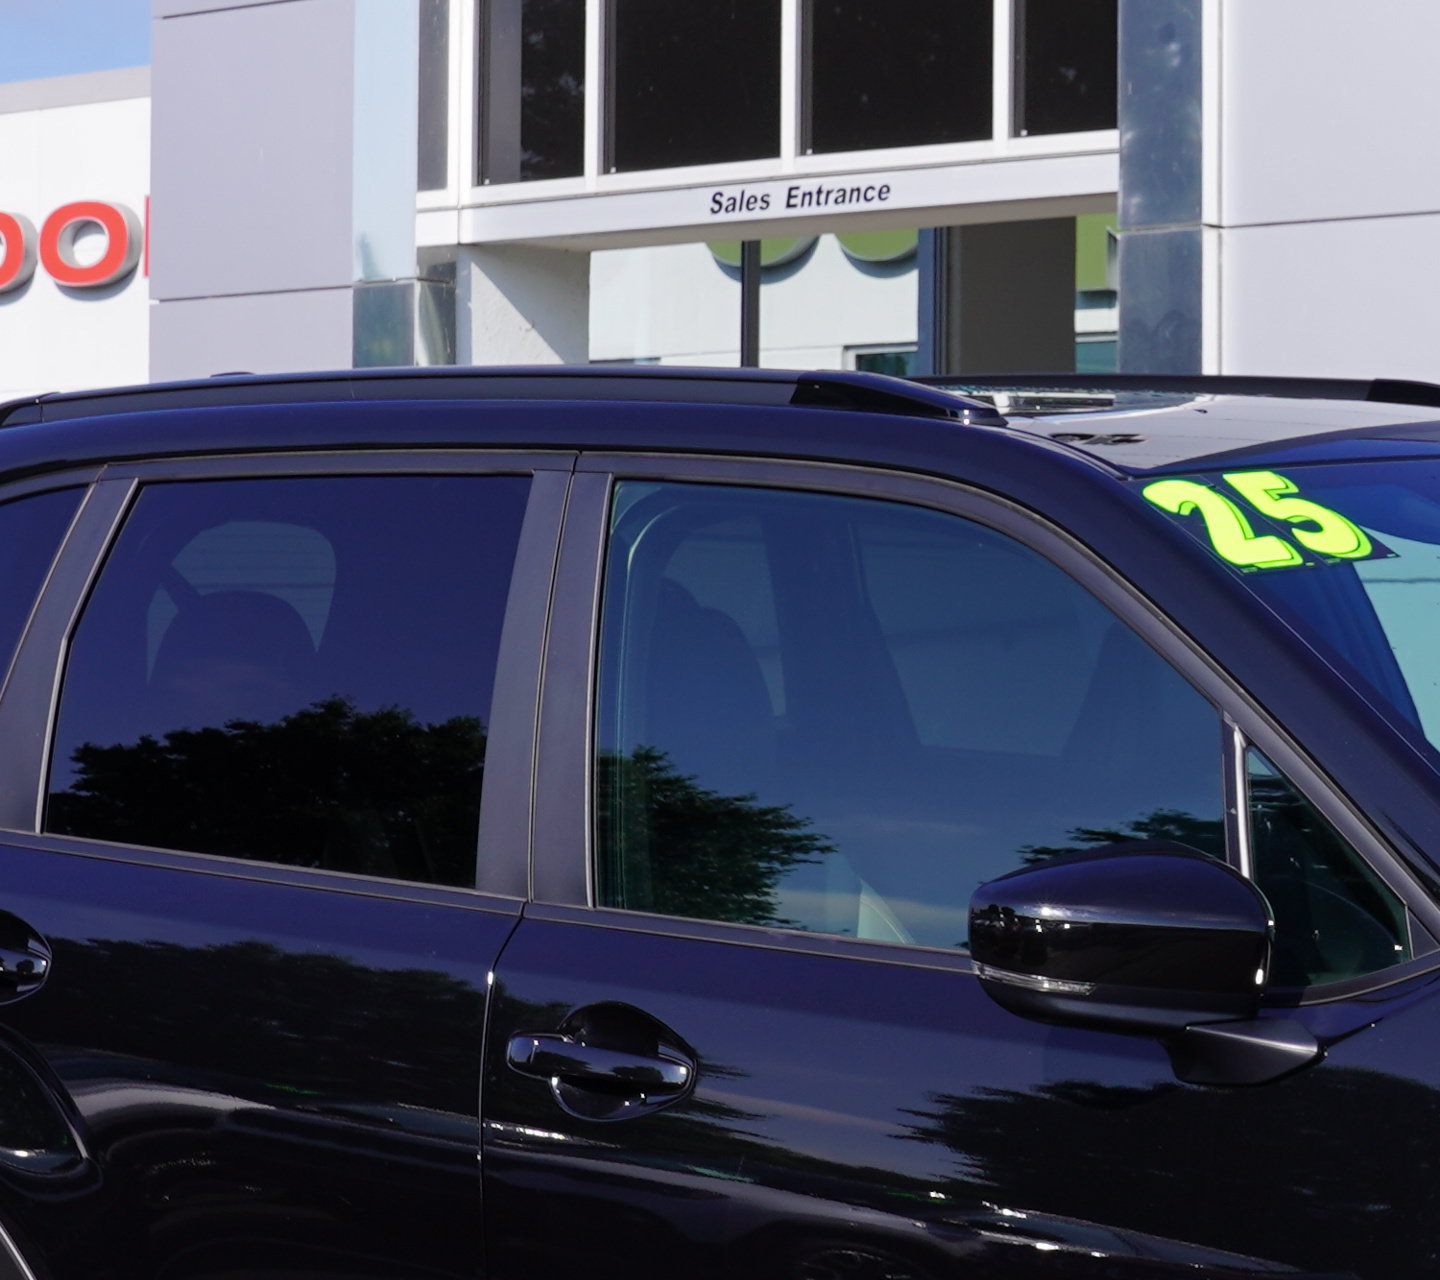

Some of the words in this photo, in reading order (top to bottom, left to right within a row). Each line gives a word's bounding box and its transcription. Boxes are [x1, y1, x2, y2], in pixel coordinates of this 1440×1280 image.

[710, 190, 771, 214] Sales
[785, 183, 891, 208] Entrance
[1142, 471, 1372, 568] 25
